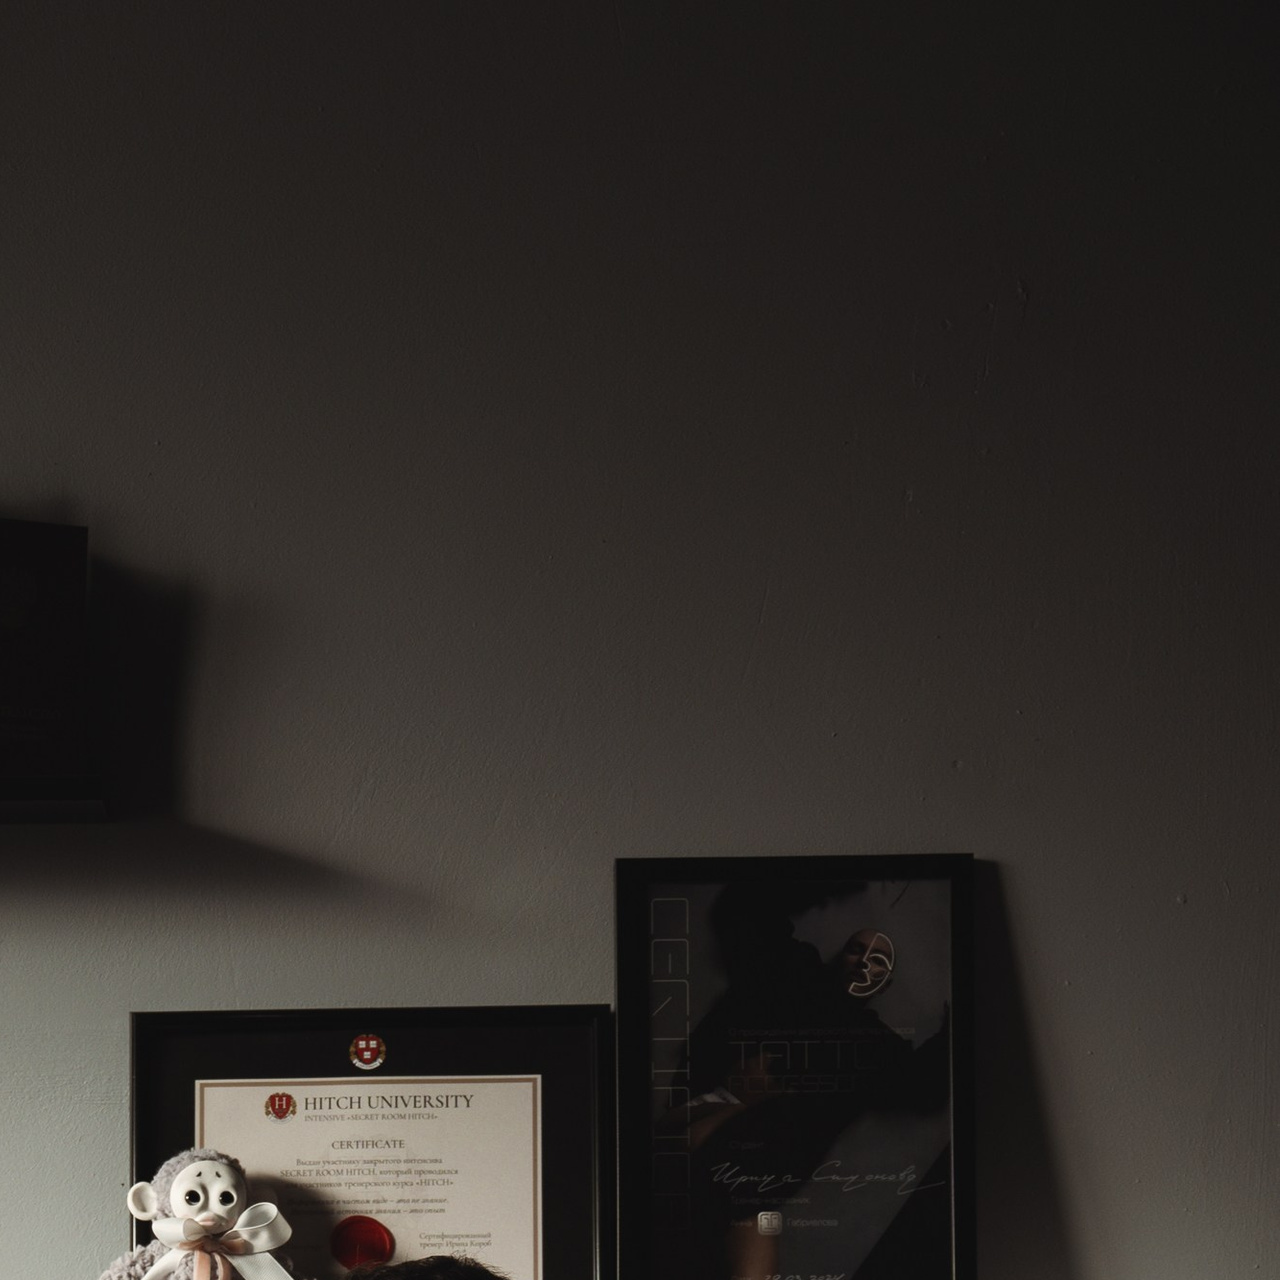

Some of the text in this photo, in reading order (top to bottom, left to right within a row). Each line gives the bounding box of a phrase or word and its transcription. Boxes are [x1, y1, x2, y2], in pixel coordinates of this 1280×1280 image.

[304, 1094, 474, 1111] HITCH UNIVERSITY
[304, 1114, 346, 1122] INTENSIVE
[331, 1139, 405, 1150] CERTIFICATE
[296, 1158, 321, 1166] Выдан
[322, 1159, 361, 1168] участнику
[363, 1158, 402, 1167] закрытого
[280, 1169, 314, 1177] SECRET
[315, 1169, 345, 1177] ROOM
[379, 1167, 413, 1178] который
[414, 1167, 459, 1177] проводился
[344, 1180, 391, 1189] тренерского
[392, 1180, 414, 1189] курса
